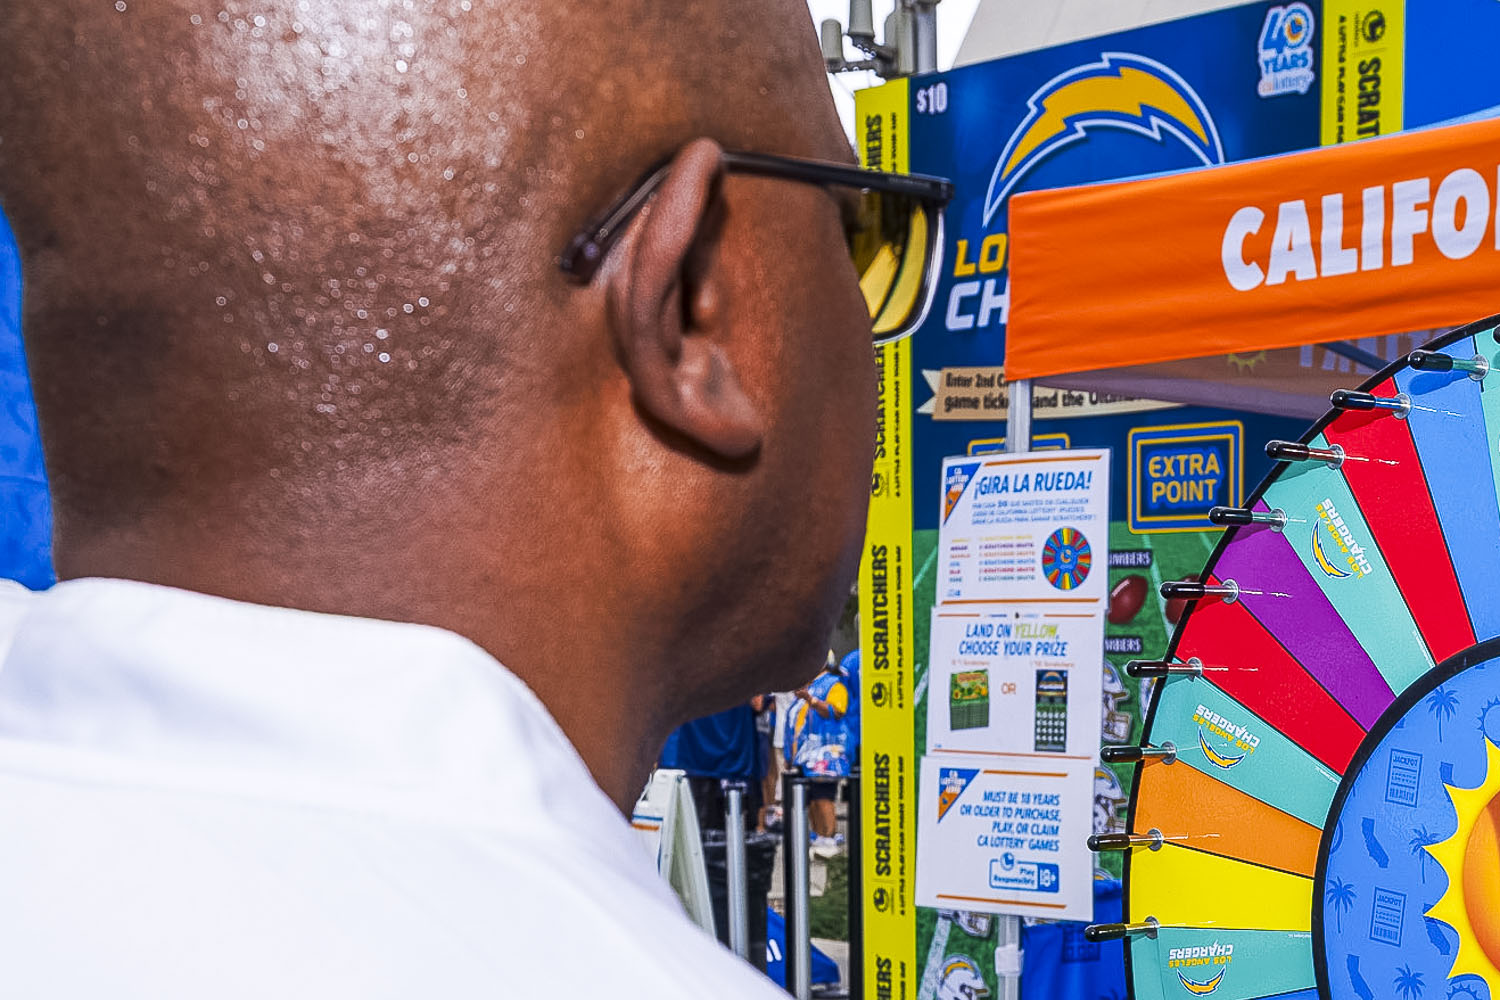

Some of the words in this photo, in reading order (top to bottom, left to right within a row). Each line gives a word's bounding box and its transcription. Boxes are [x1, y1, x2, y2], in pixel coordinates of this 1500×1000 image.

[1263, 50, 1308, 74] YEARS
[917, 82, 947, 114] $10
[1356, 57, 1381, 137] SCRAT
[953, 233, 1009, 277] LO
[945, 372, 973, 388] Enter
[975, 372, 994, 388] 2nd
[944, 395, 980, 413] game
[1062, 390, 1083, 408] the
[1148, 453, 1221, 478] EXTRA
[1013, 474, 1030, 493] LA
[1034, 471, 1092, 492] RUEDA!
[1151, 479, 1217, 503] POINT
[1321, 498, 1373, 575] CHARGERS
[872, 545, 889, 670] SCRATCHERS
[966, 623, 993, 638] LAND
[996, 623, 1012, 638] ON
[959, 640, 999, 656] CHOOSE
[1004, 641, 1032, 656] YOUR
[1035, 641, 1068, 657] PRIZE
[1001, 682, 1016, 695] OR
[1195, 704, 1261, 748] CHARGERS
[983, 791, 1006, 803] MUST
[1033, 793, 1060, 806] YEARS
[874, 753, 891, 877] SCRATCHERS
[960, 804, 972, 816] OR
[974, 805, 1000, 818] OLDER
[1002, 807, 1013, 818] TO
[1016, 823, 1029, 834] OR
[1030, 823, 1059, 836] CLAIM
[977, 835, 988, 847] CA
[1028, 839, 1060, 852] GAMES
[1169, 940, 1233, 960] CHARGERS
